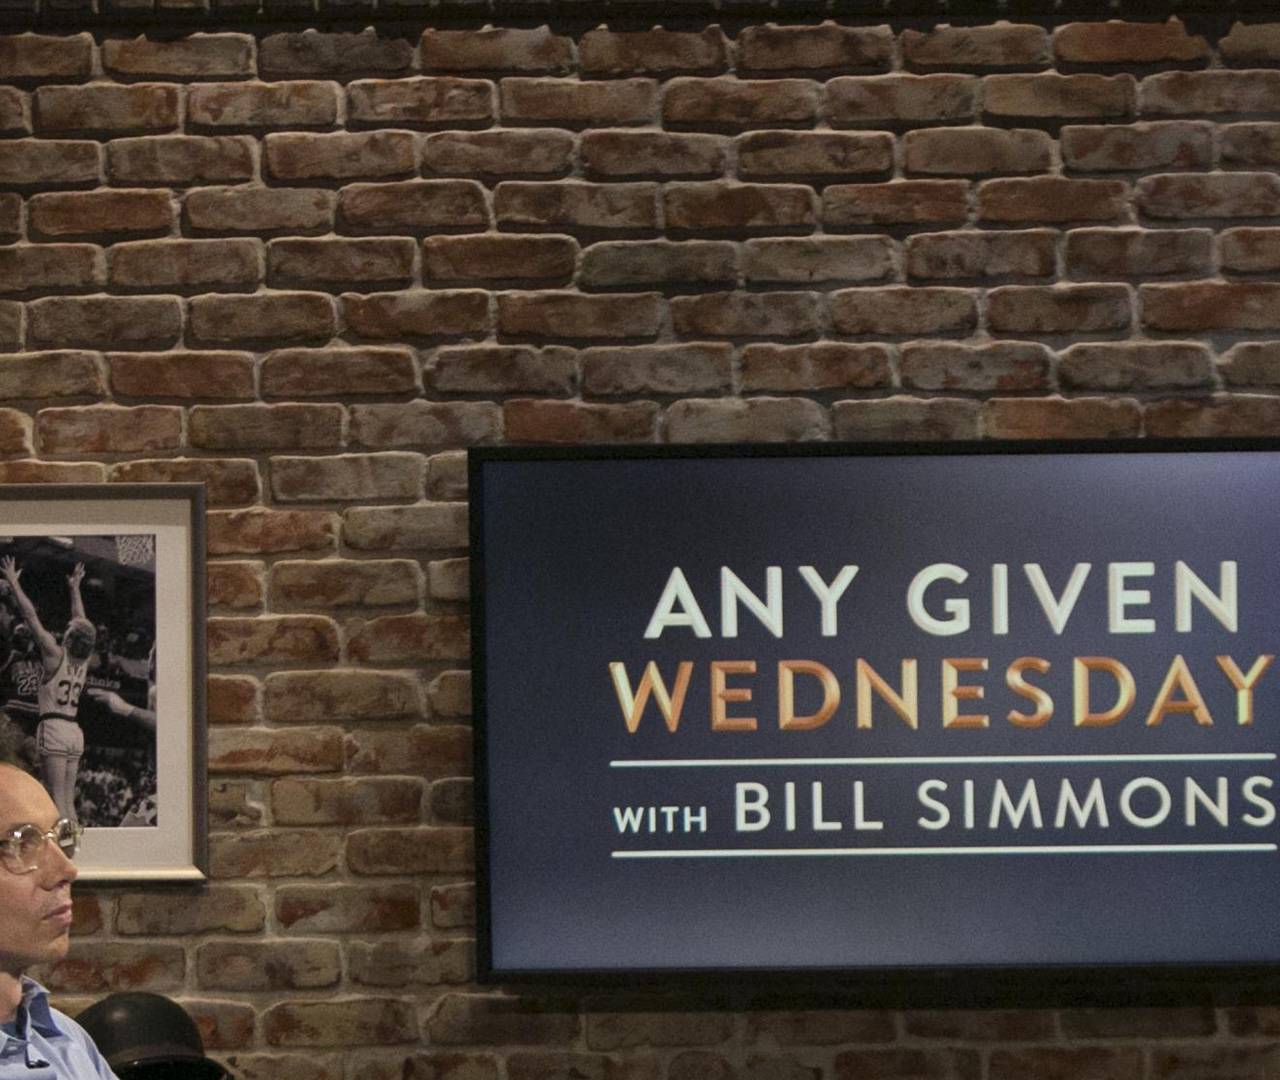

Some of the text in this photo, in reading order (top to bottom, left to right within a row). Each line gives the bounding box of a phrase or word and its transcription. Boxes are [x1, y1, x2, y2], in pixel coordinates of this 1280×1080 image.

[643, 560, 1239, 640] ANY GIVEN
[607, 653, 1277, 734] WEDNESDAY
[612, 774, 1277, 834] WITH BILL SIMMONS
